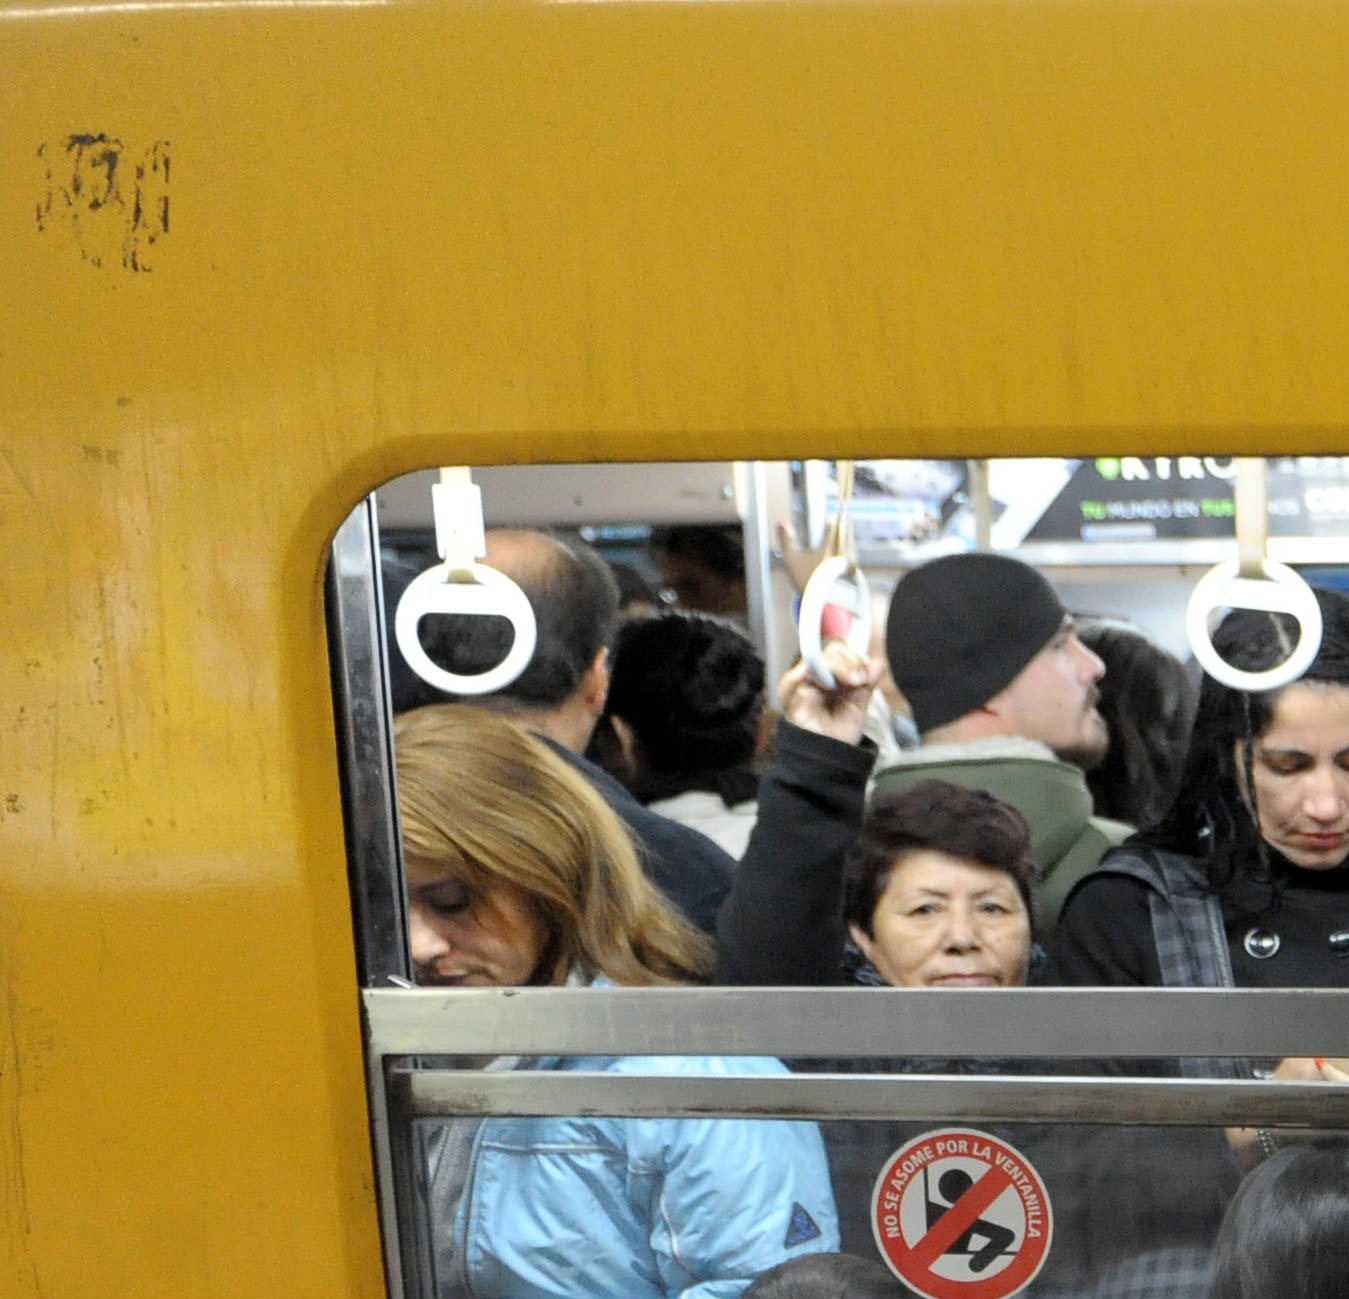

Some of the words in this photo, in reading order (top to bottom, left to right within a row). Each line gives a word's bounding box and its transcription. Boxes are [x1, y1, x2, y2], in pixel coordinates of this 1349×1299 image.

[936, 1140, 968, 1155] POR
[973, 1142, 992, 1159] LA
[893, 1146, 934, 1192] ASOME
[885, 1192, 900, 1210] SE
[996, 1152, 1042, 1238] VENTANILLA
[884, 1216, 900, 1238] NO
